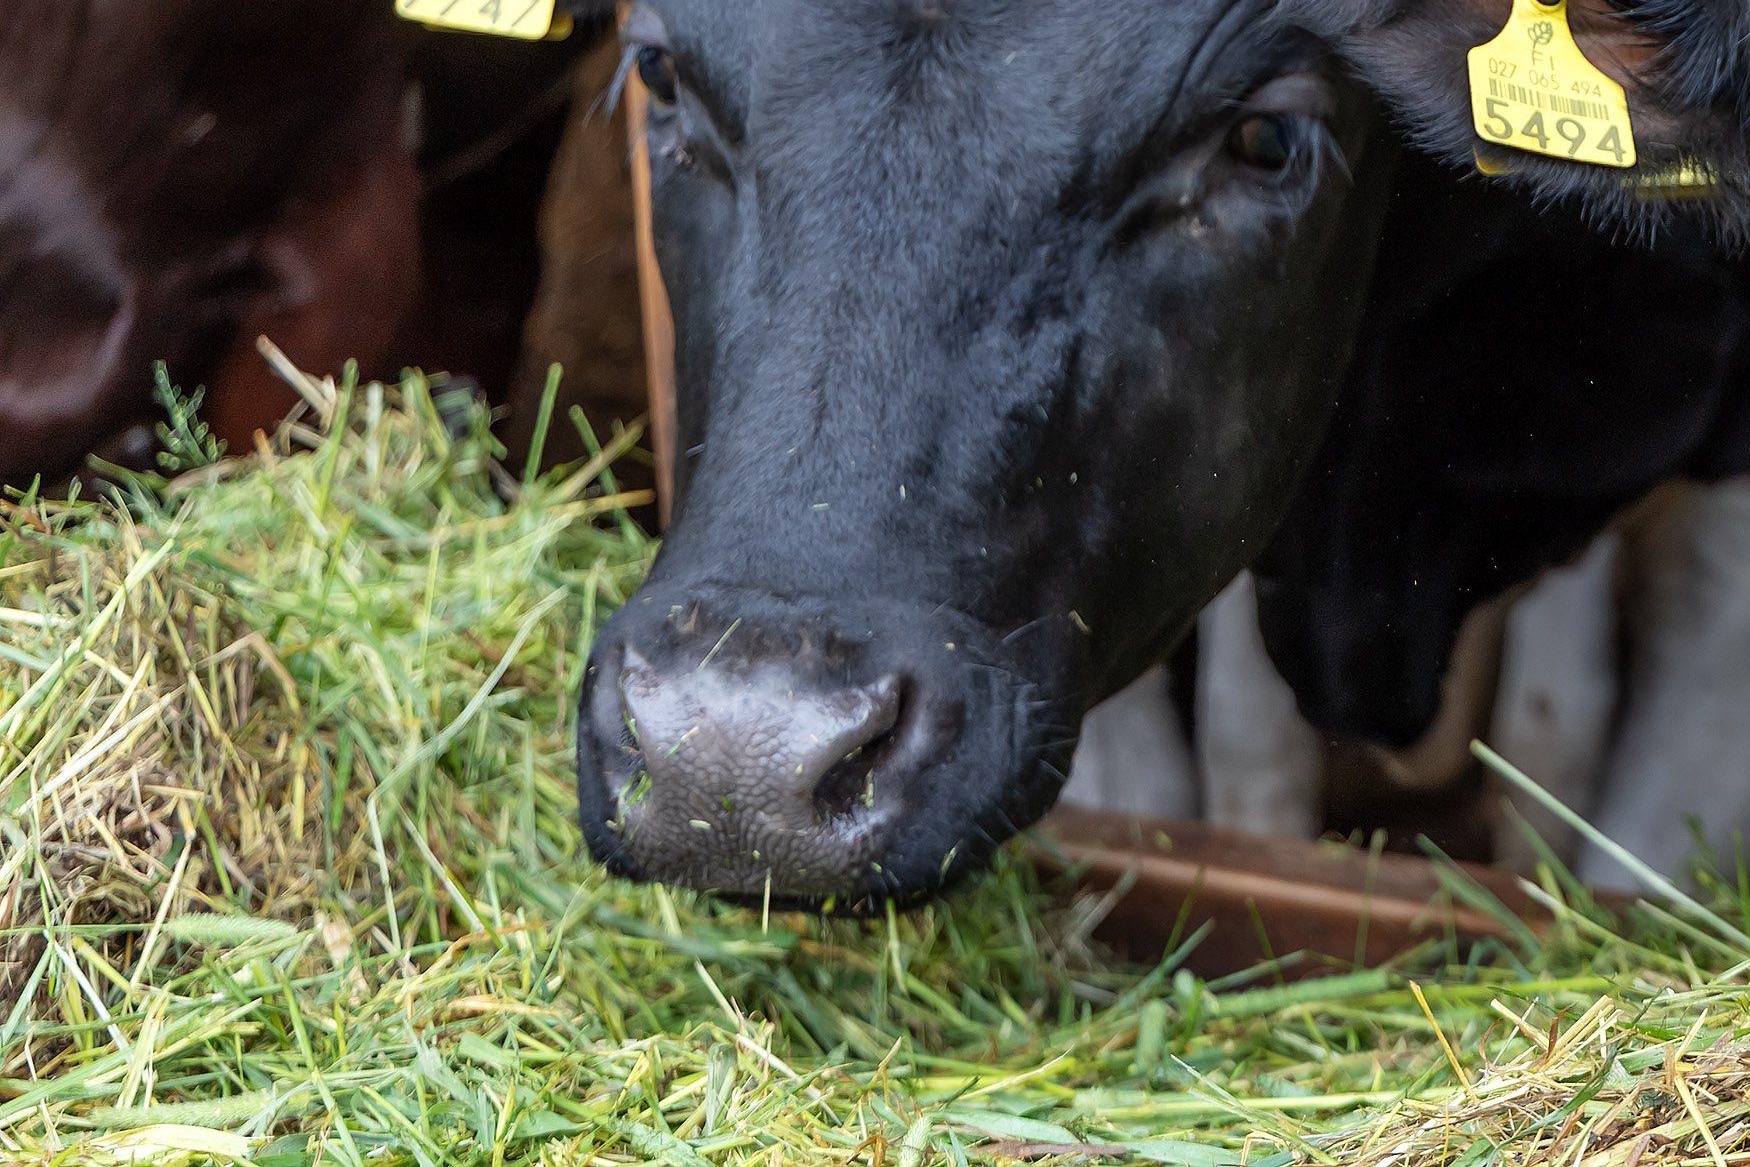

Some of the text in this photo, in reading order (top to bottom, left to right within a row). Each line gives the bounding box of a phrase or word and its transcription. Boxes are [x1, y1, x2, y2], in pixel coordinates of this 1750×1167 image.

[1488, 57, 1602, 98] 027 065 494
[1484, 97, 1627, 163] 5494
